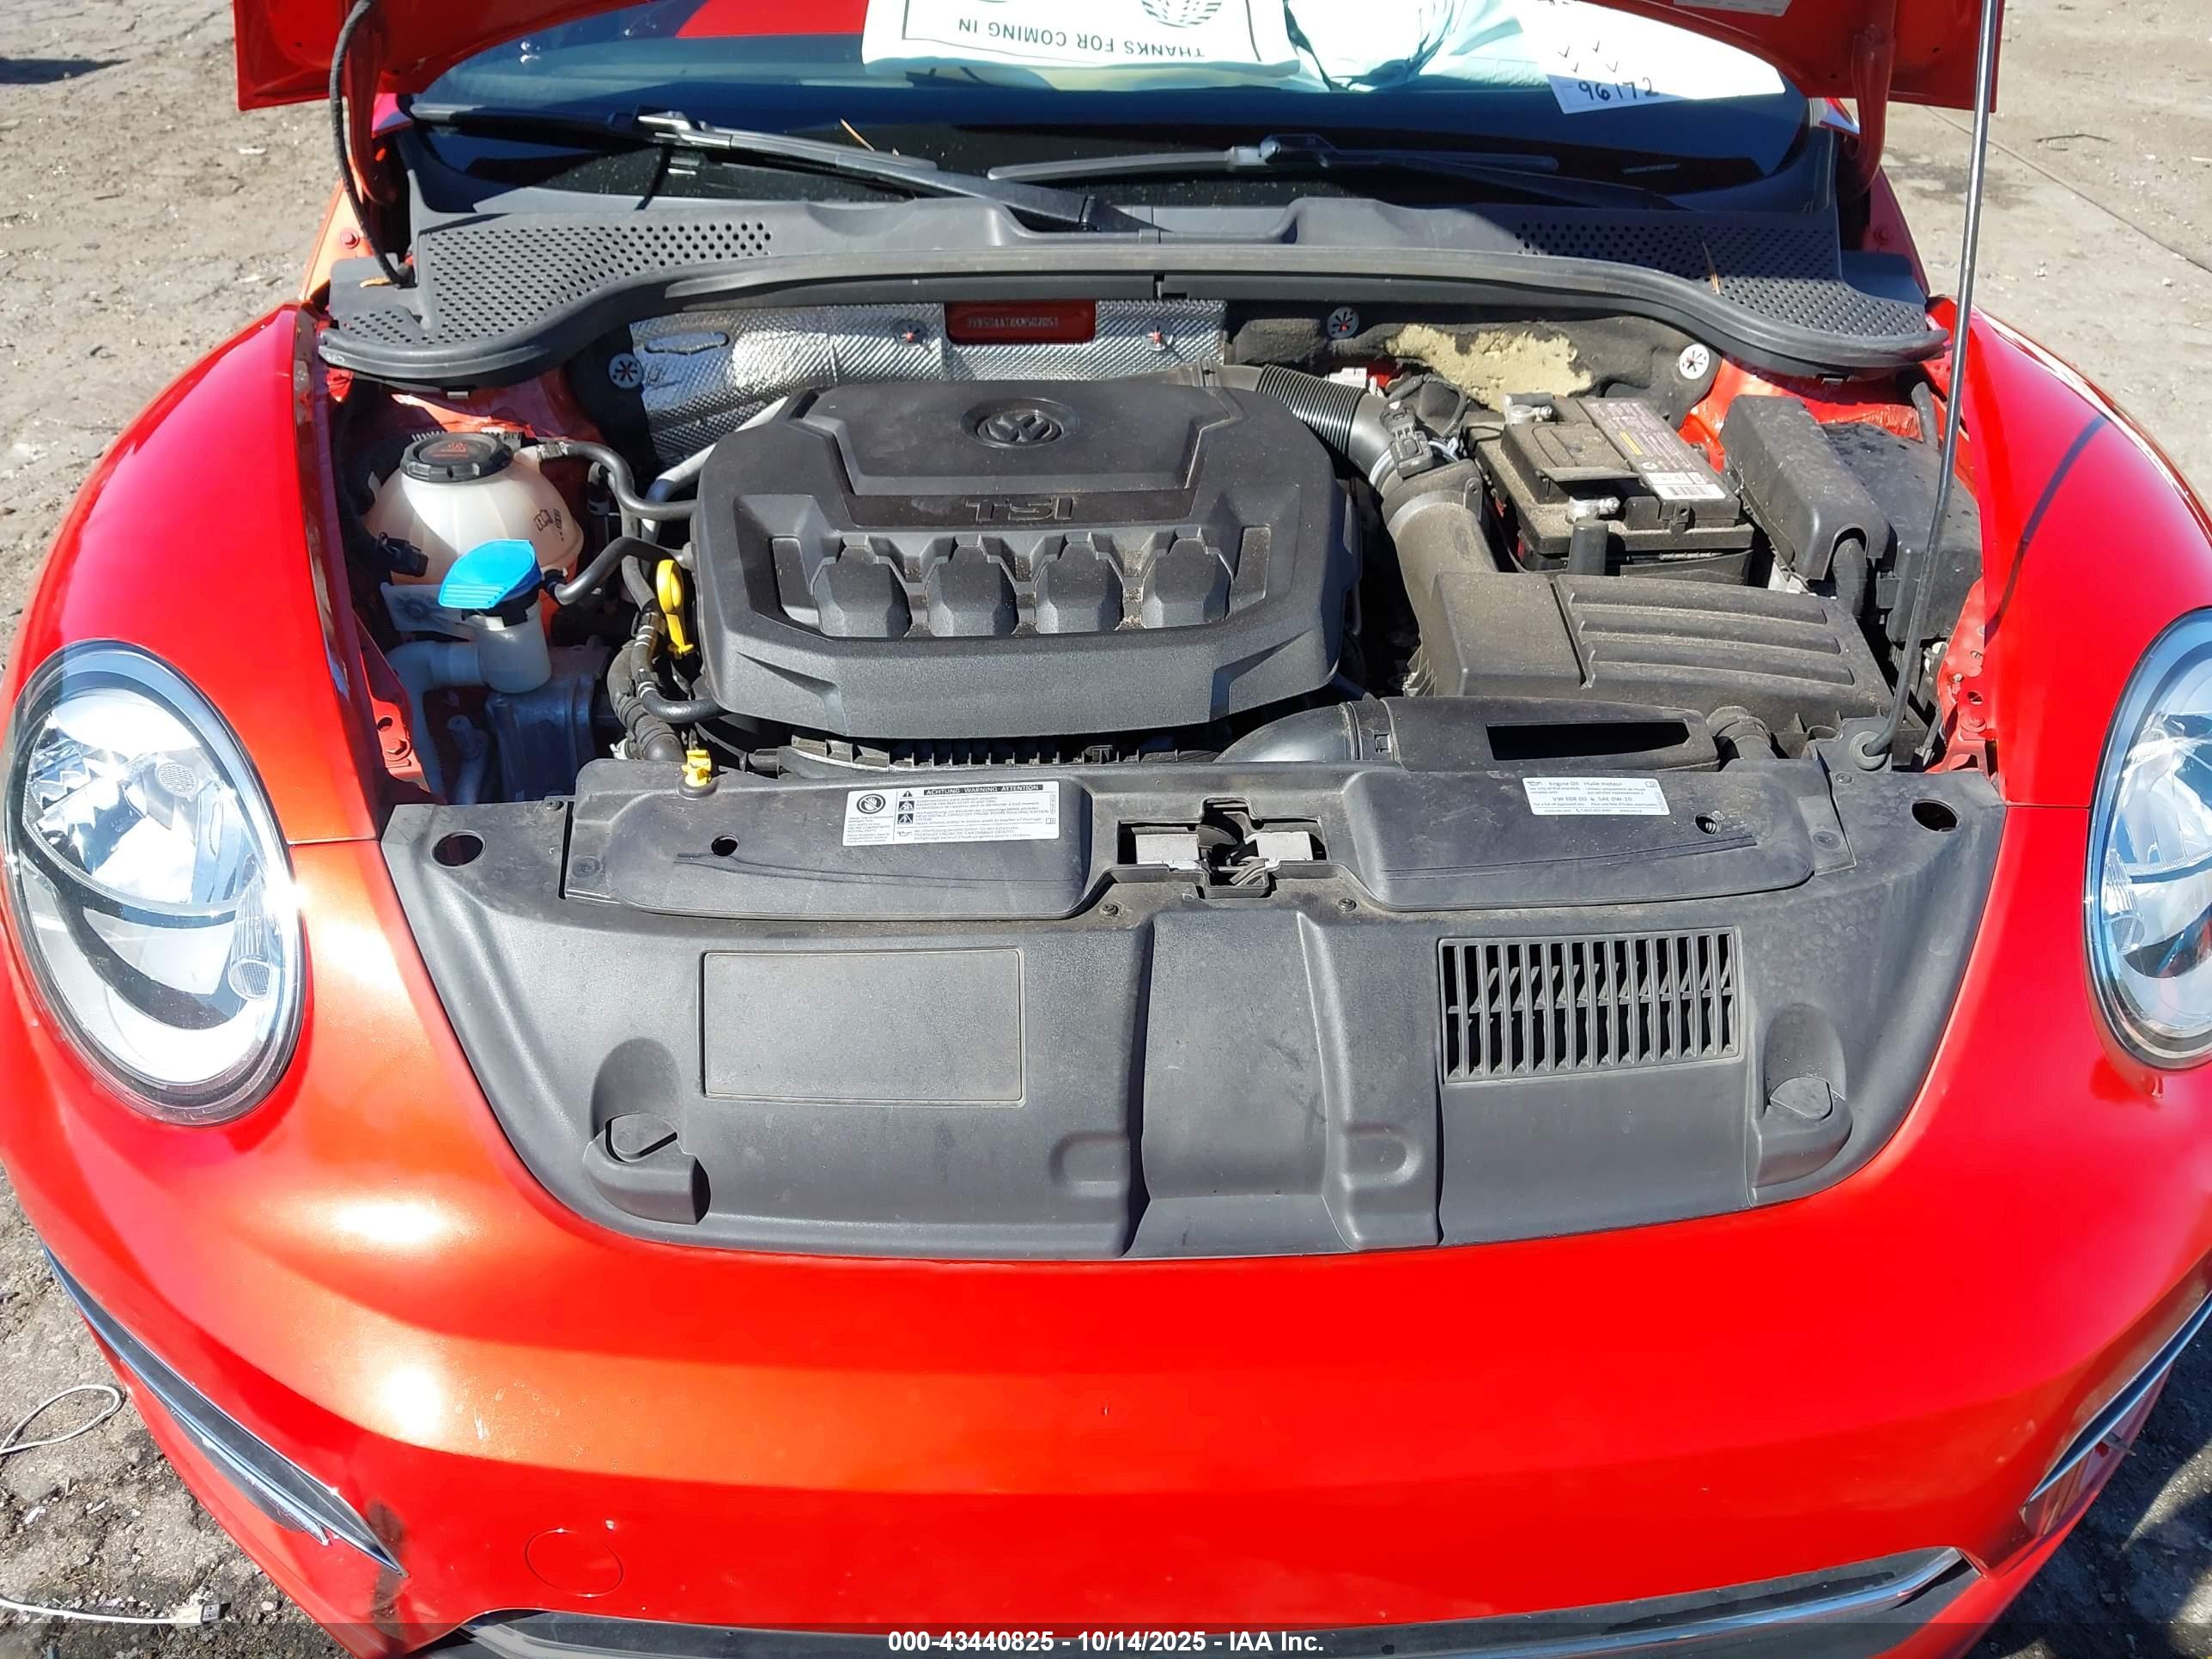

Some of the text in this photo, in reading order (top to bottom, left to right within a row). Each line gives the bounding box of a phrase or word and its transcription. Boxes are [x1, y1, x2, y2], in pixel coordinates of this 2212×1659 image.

[957, 17, 1205, 58] THANKS FOR COMING IN
[1577, 76, 1659, 102] 96172
[965, 496, 1075, 522] TSI
